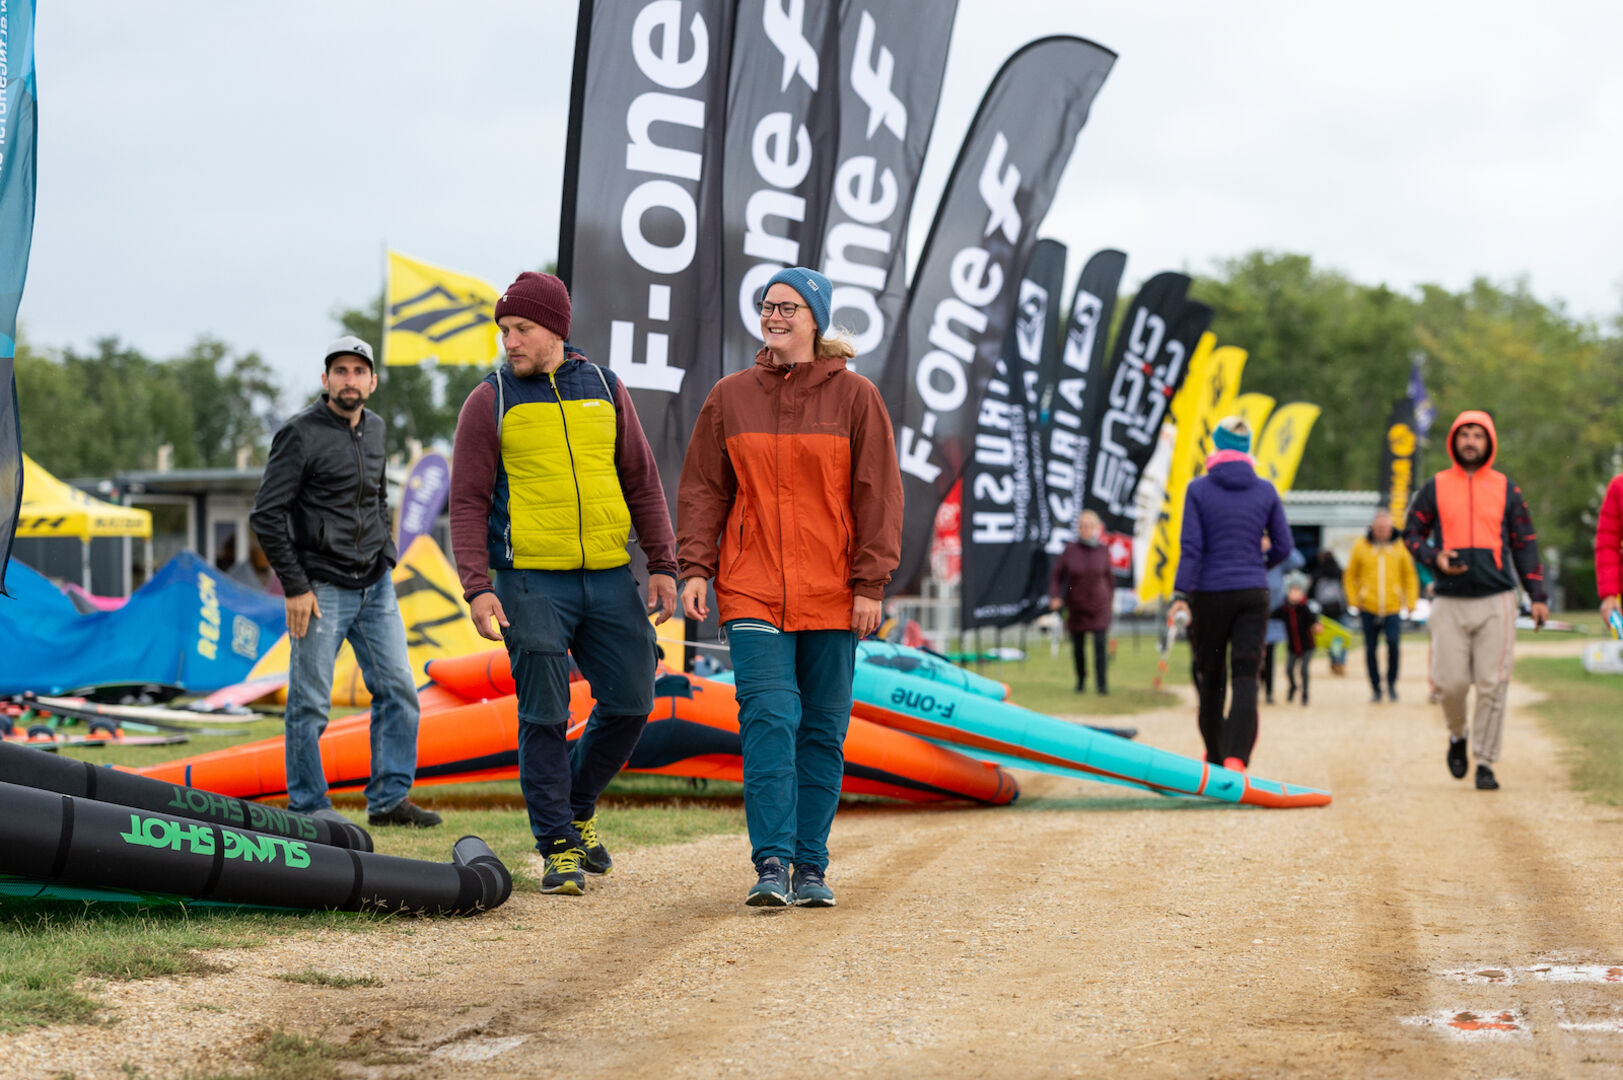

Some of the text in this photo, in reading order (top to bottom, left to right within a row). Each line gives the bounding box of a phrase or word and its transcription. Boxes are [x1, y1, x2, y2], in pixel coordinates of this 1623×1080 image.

[609, 0, 709, 393] F-one
[738, 112, 812, 343] one
[824, 155, 898, 358] one
[900, 246, 1004, 484] F-one
[891, 688, 955, 718] F-one
[120, 814, 311, 868] SLINGSHOT
